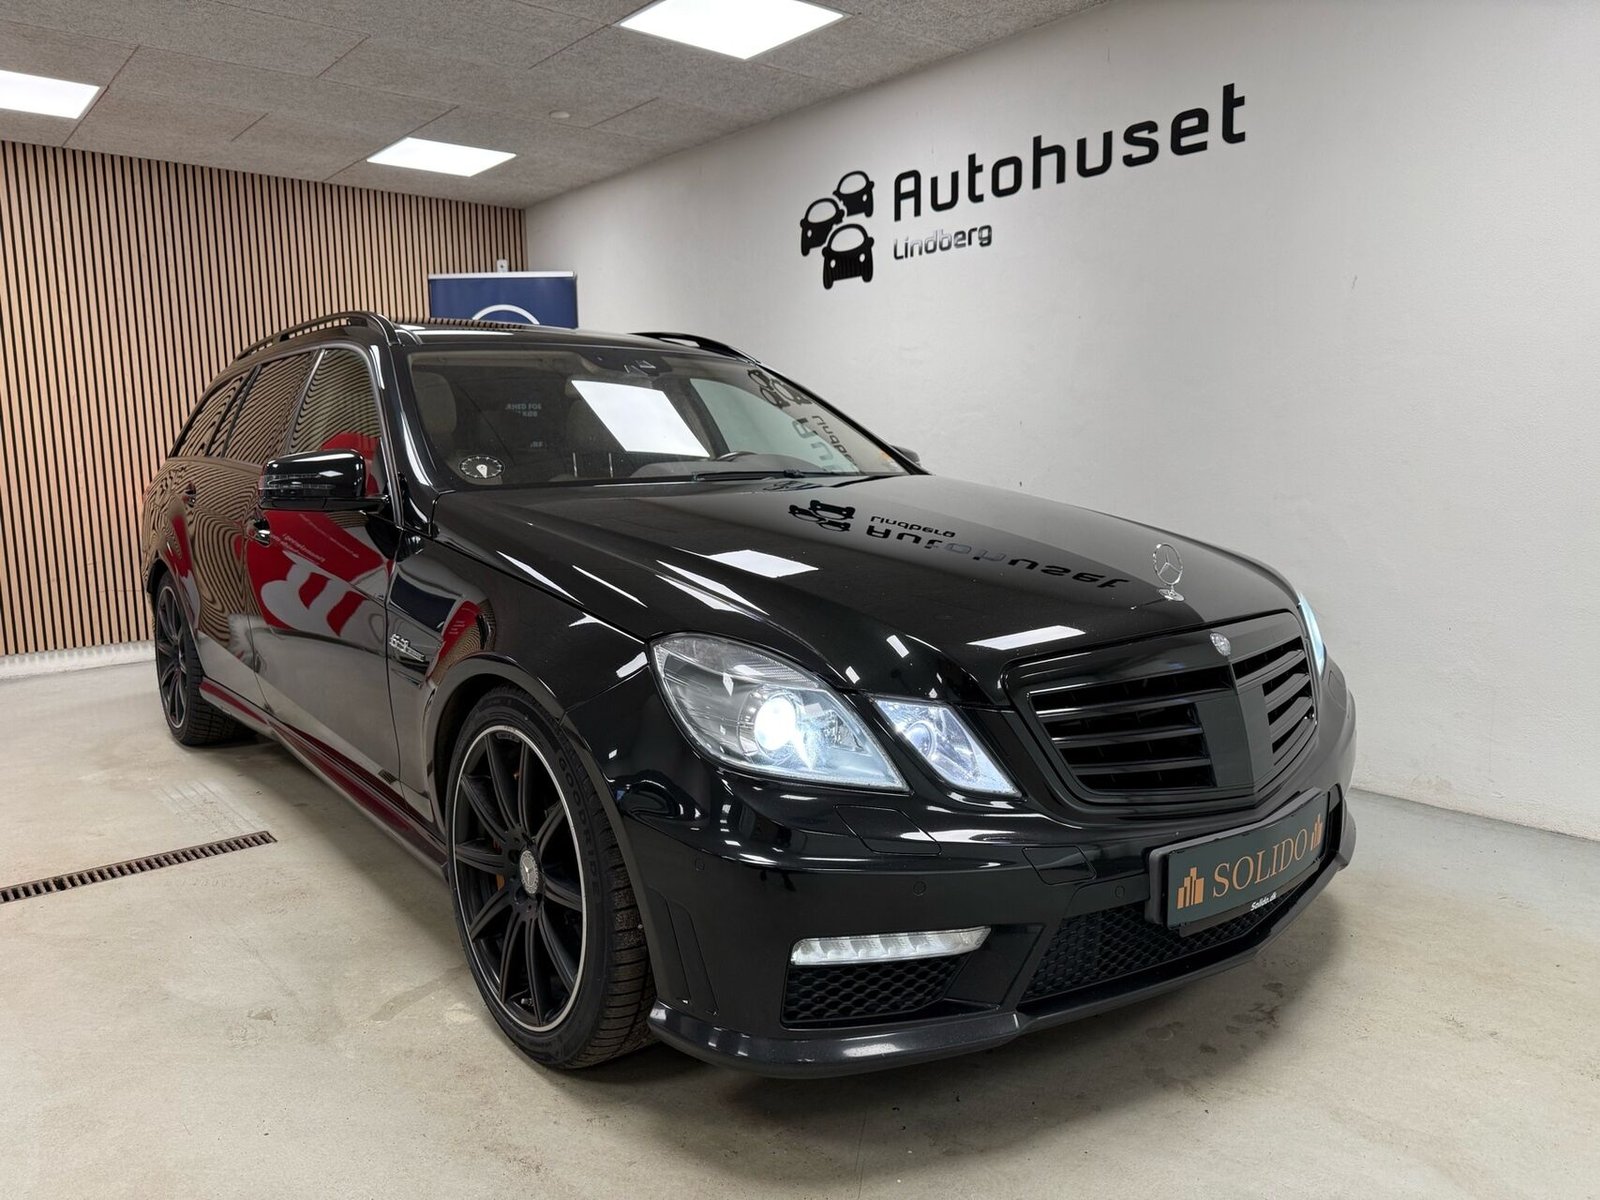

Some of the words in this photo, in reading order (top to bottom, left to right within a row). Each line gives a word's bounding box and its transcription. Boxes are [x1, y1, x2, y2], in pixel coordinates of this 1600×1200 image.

[893, 82, 1246, 222] Autohuset
[893, 224, 993, 260] Lindberg
[1212, 828, 1308, 898] SOLIDO
